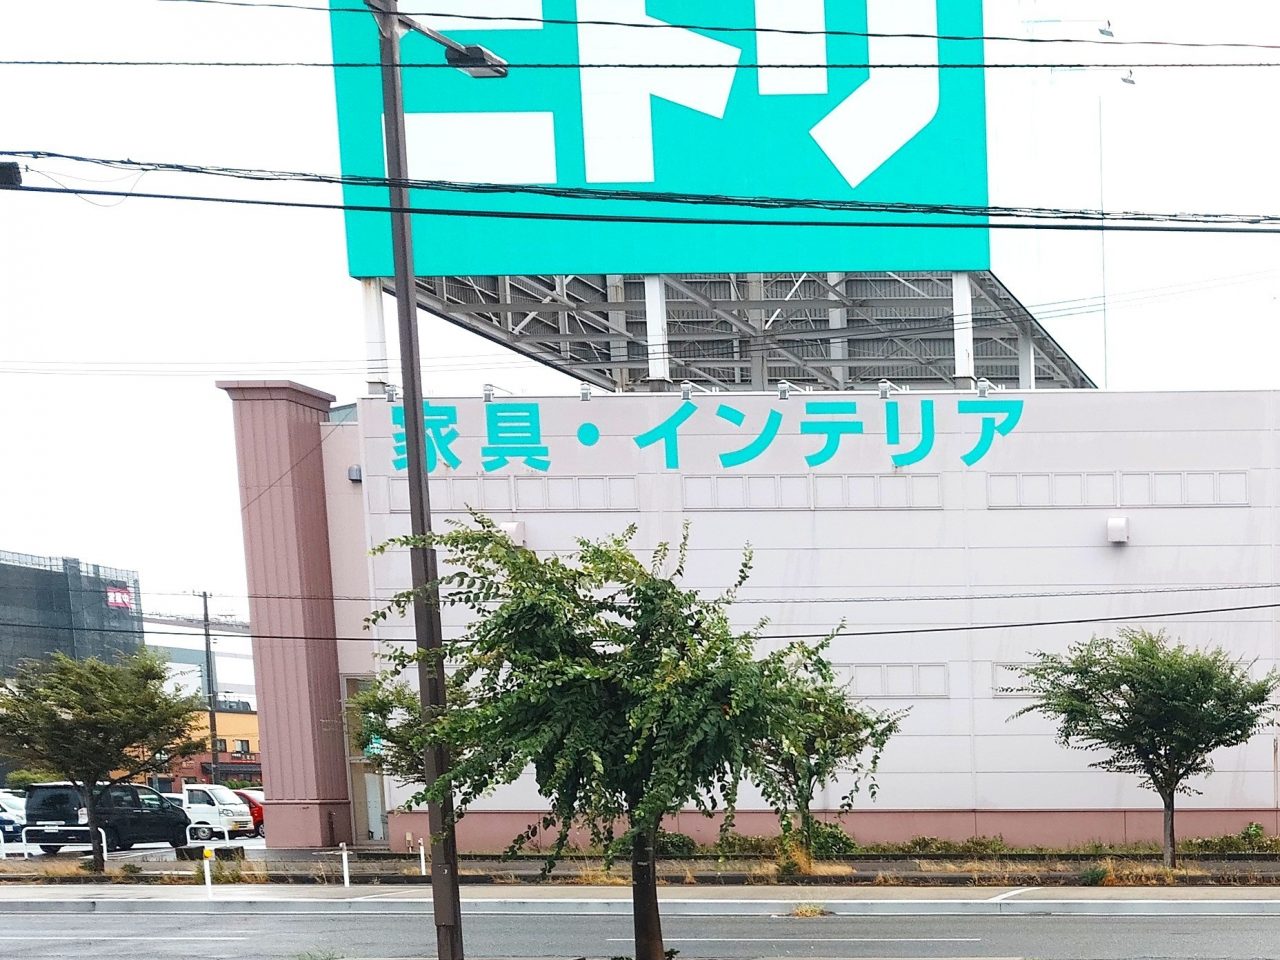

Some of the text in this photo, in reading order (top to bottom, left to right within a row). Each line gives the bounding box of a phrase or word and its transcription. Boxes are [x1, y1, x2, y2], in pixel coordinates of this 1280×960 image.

[381, 0, 940, 189] ニトリ
[391, 400, 1023, 472] 家具・インテリア
